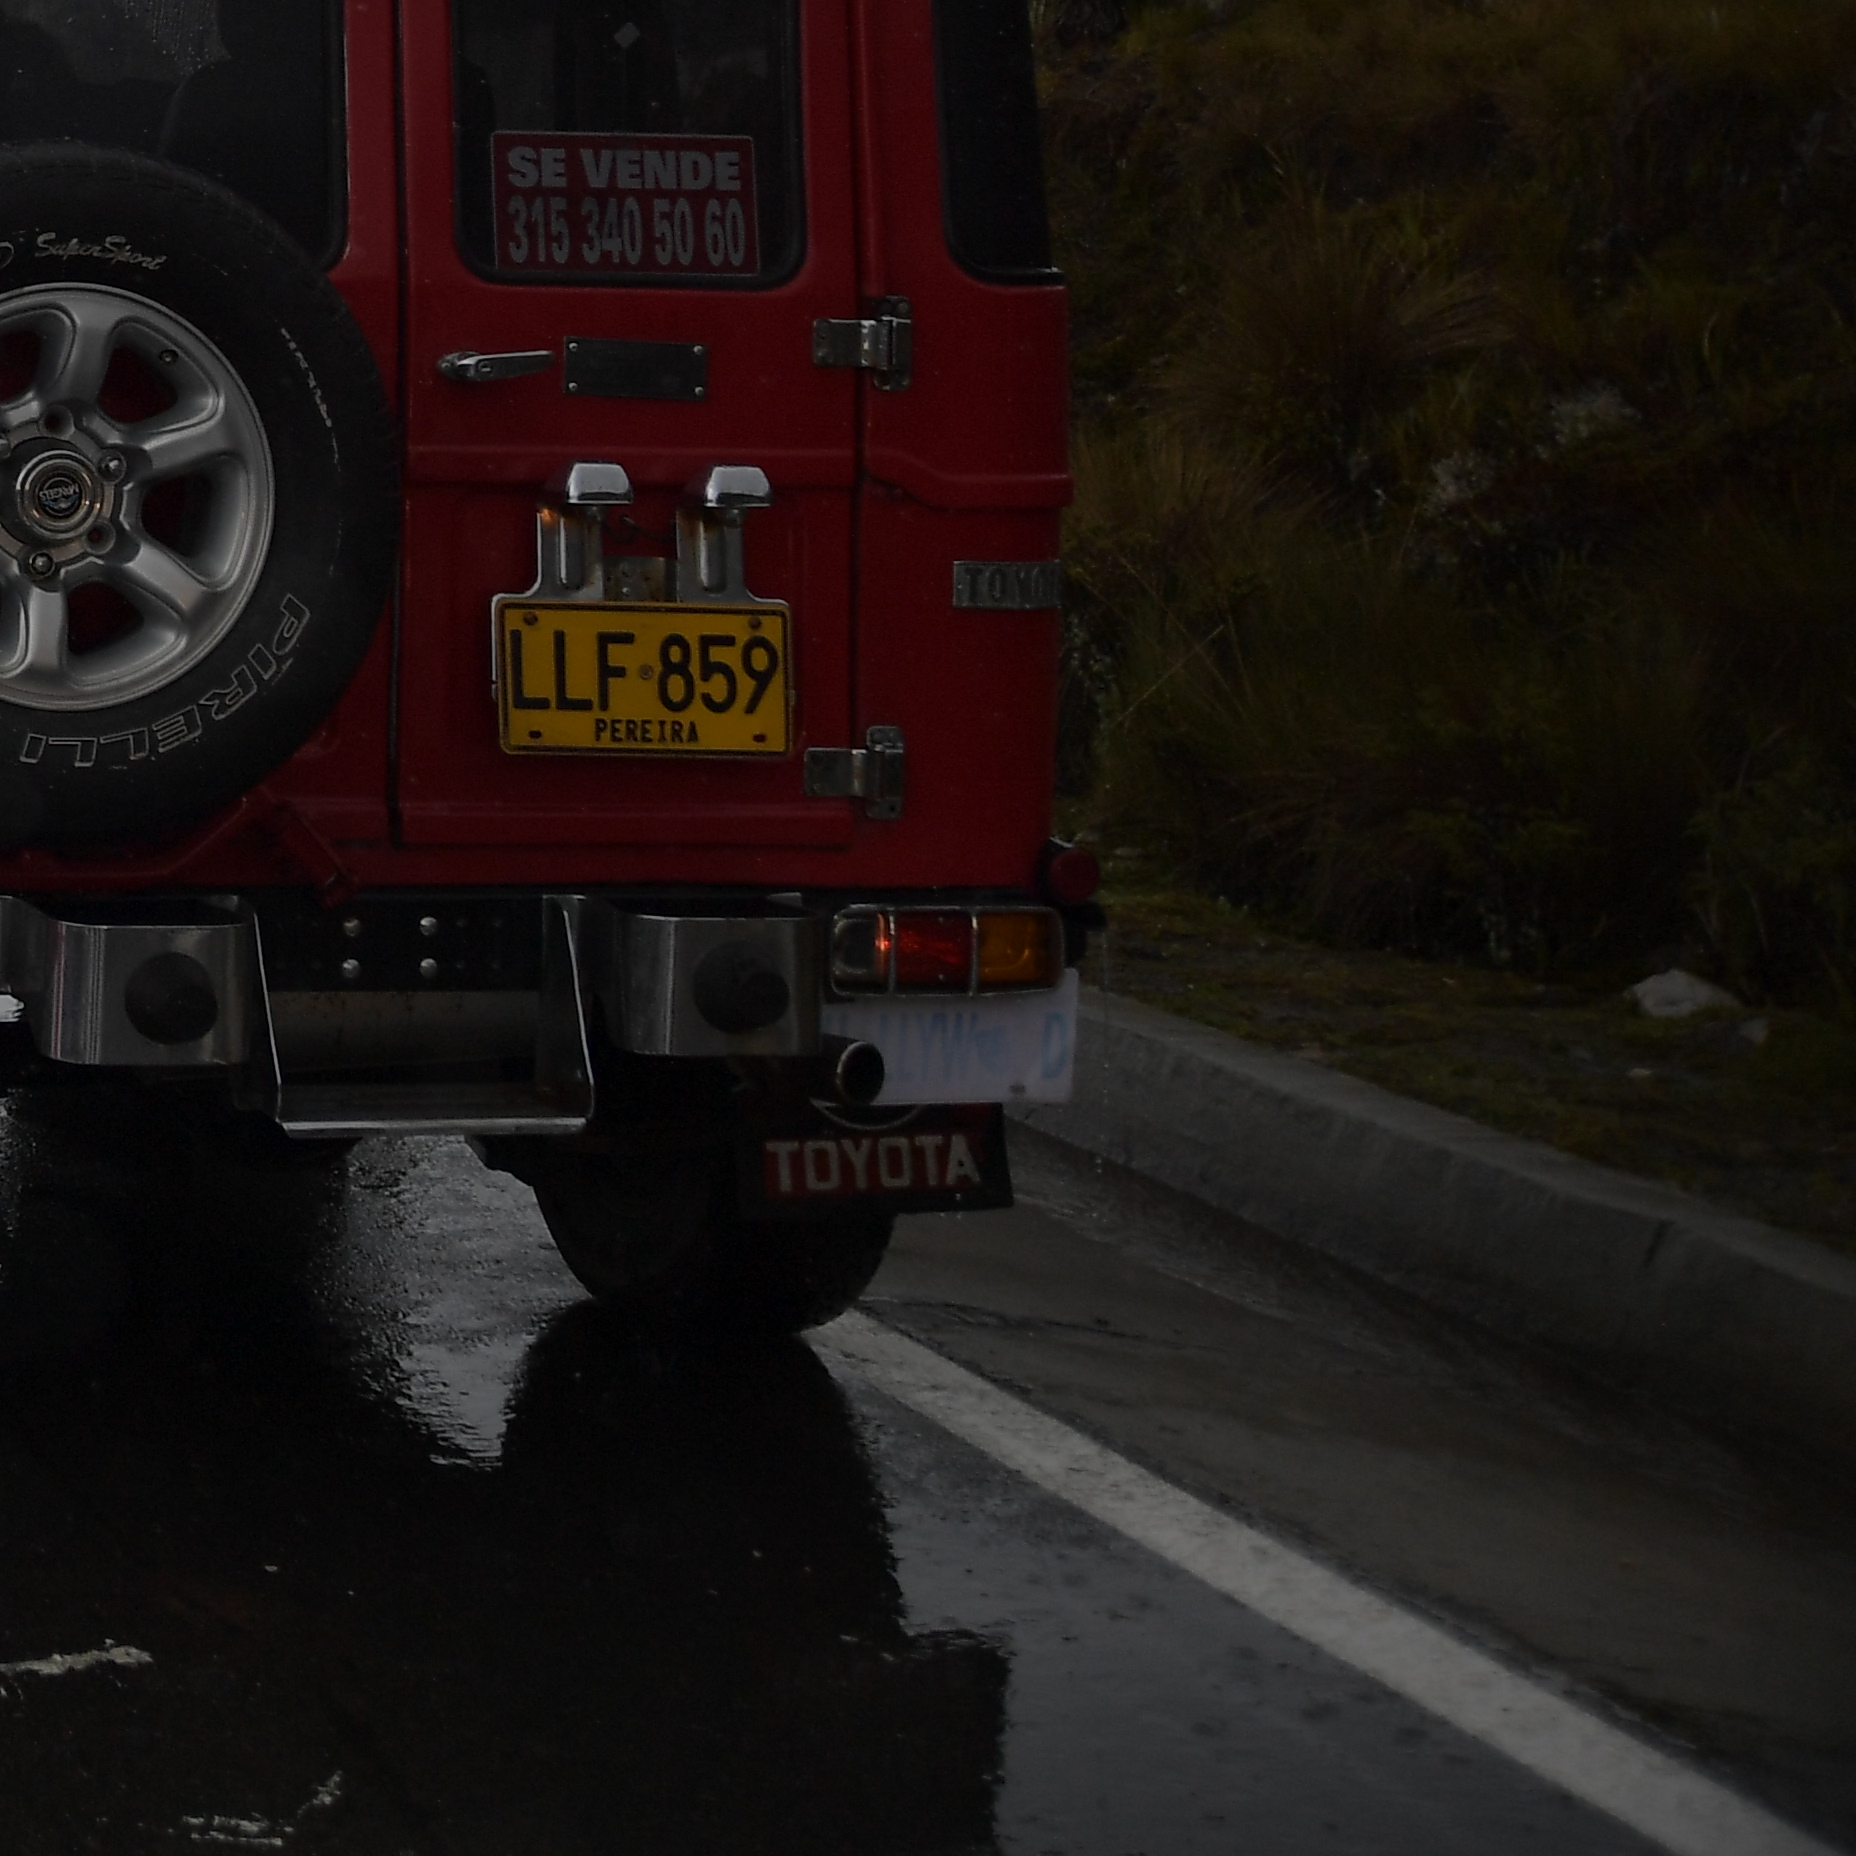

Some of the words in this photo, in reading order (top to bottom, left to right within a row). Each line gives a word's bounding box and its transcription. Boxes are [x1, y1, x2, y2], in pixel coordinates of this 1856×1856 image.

[507, 147, 568, 188] SE
[580, 148, 742, 192] VENDE
[508, 195, 570, 264] 315
[581, 196, 643, 265] 340
[653, 197, 694, 266] 50
[704, 198, 745, 267] 60
[18, 592, 311, 770] PIRELLI
[510, 628, 636, 712] LLF
[658, 632, 779, 716] 859
[594, 718, 700, 744] PEREIRA
[766, 1135, 981, 1193] TOYOTA
